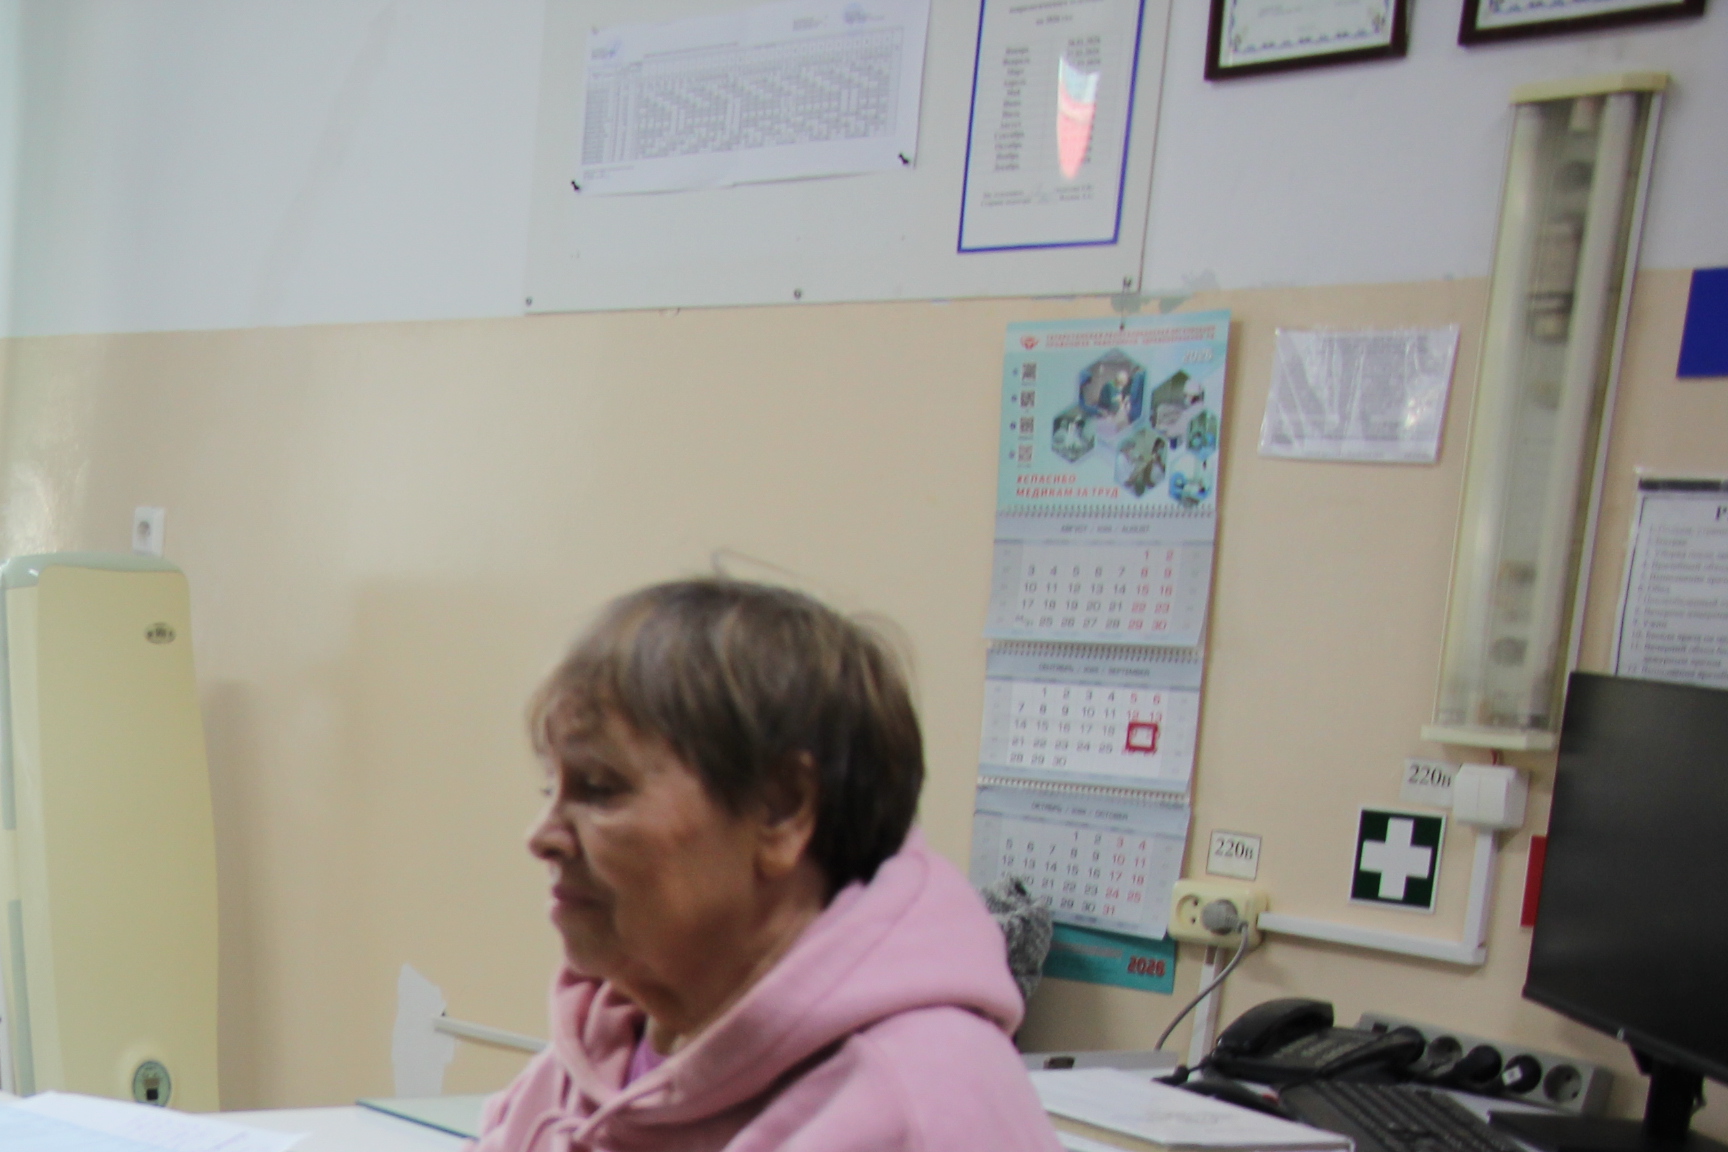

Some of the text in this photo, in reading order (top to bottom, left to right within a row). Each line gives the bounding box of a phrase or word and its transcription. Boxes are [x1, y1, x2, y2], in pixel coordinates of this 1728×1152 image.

[1016, 488, 1072, 497] МЕДИКАМ
[1092, 488, 1118, 498] ТРУД
[1144, 550, 1149, 559] 1
[1028, 567, 1171, 578] 3 4 5 6 7 8 9
[1025, 583, 1172, 596] 10 11 12 13 14 15 16
[1022, 600, 1169, 614] 17 18 19 20 21 22 23
[1039, 616, 1053, 627] 25
[1061, 617, 1074, 628] 26
[1083, 617, 1097, 628] 27
[1105, 618, 1119, 629] 28
[1128, 619, 1143, 630] 29
[1152, 619, 1167, 631] 30
[1042, 687, 1160, 705] 1 2 3 4 5 6
[1018, 703, 1162, 722] 7 8 9 10 11 12 13
[1014, 719, 1115, 735] 14 15 16 17 18
[1012, 736, 1024, 746] 21
[1033, 738, 1046, 748] 22
[1055, 740, 1068, 750] 23
[1077, 741, 1090, 751] 24
[1099, 743, 1113, 753] 25
[1010, 752, 1067, 766] 28 29 30
[1074, 831, 1146, 850] 1 2 3 4
[1006, 838, 1146, 867] 5 6 7 8 9 10 11
[1002, 855, 1144, 885] 12 13 14 15 16 17 18
[1042, 878, 1054, 888] 21
[1063, 881, 1076, 892] 22
[1084, 884, 1097, 895] 23
[1106, 887, 1119, 899] 24
[1127, 891, 1141, 902] 25
[1060, 897, 1073, 908] 29
[1082, 901, 1095, 912] 30
[1103, 904, 1115, 915] 31
[1128, 956, 1165, 977] 2026
